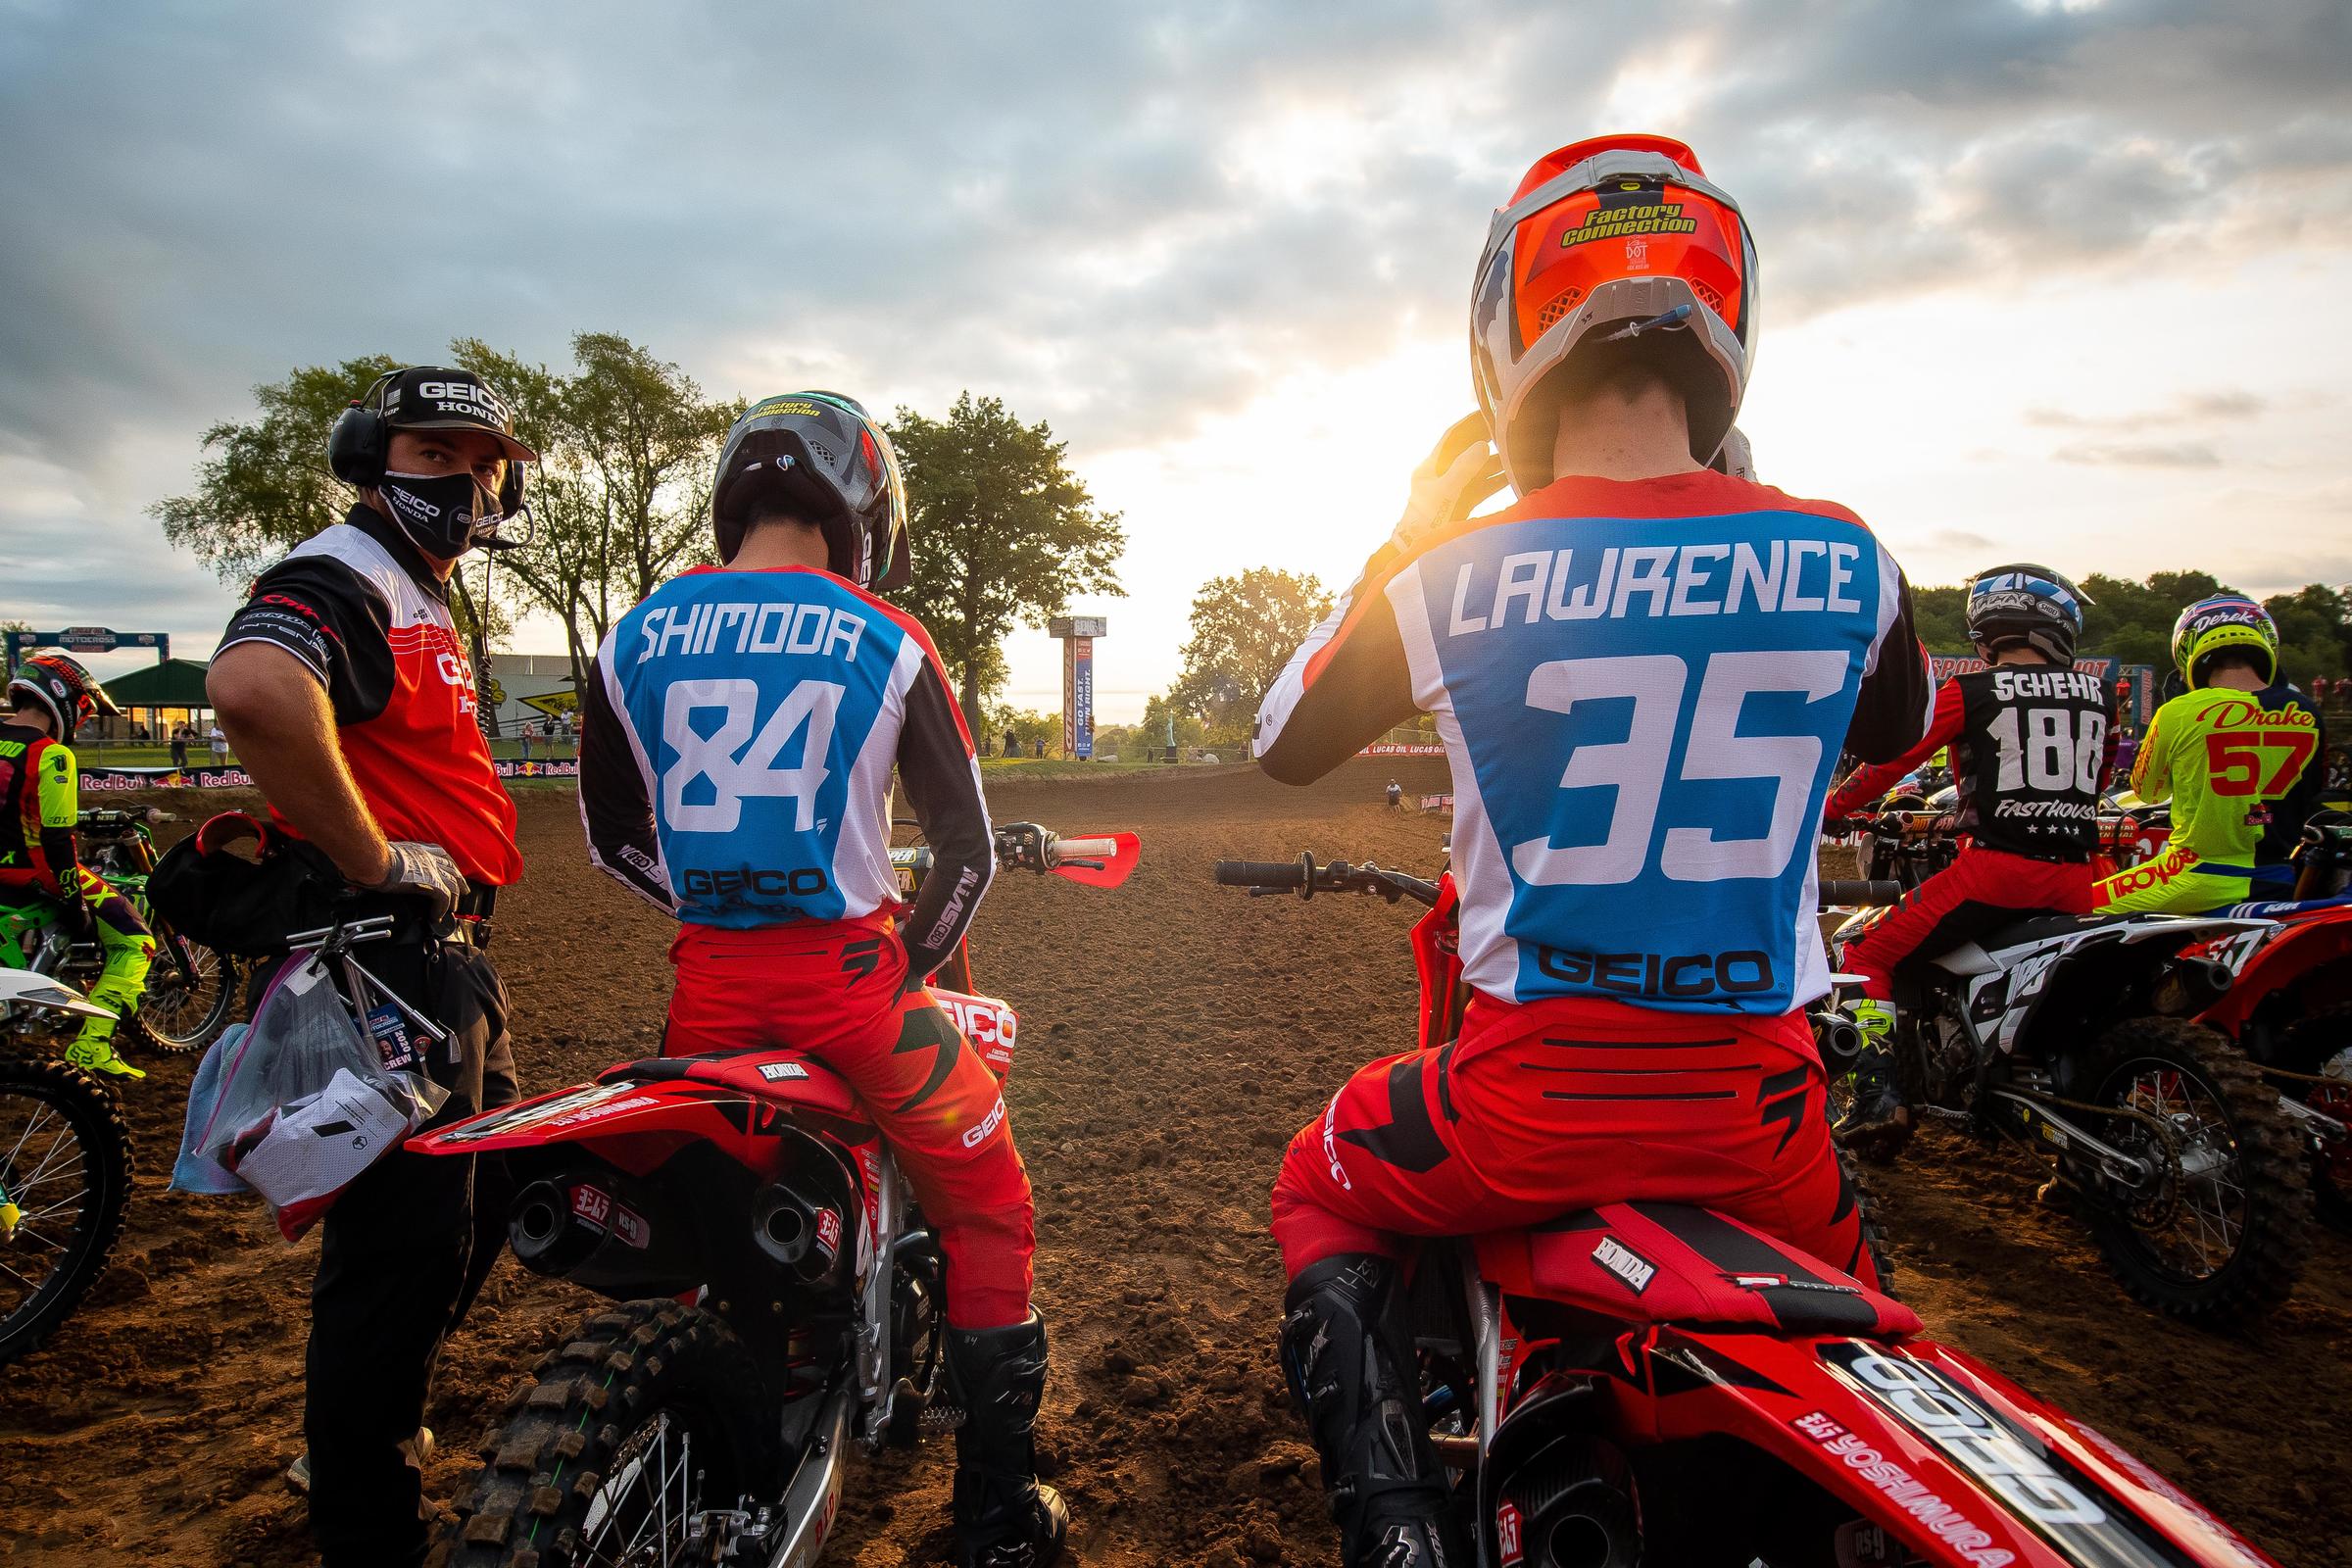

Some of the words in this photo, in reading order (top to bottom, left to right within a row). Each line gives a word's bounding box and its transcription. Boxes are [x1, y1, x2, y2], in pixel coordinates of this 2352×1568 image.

[1585, 204, 1681, 226] Factory
[1561, 218, 1695, 247] Connection
[419, 381, 509, 422] GEICO
[436, 401, 506, 432] HONDA
[392, 485, 440, 517] GEICO
[392, 496, 428, 522] HONDA
[475, 512, 503, 527] GEICO
[1448, 539, 1861, 637] LAWRENCE
[2040, 603, 2059, 616] SHOEI
[2193, 611, 2255, 632] Derek
[637, 603, 867, 664] SHIMODA
[1991, 671, 2105, 706] SCHEHR
[1078, 710, 1084, 726] GO
[2196, 700, 2317, 728] Drake
[496, 763, 513, 775] Bull
[546, 762, 564, 775] Red
[662, 679, 847, 833] 84
[1512, 650, 1850, 886] 35
[2205, 728, 2319, 800] 57
[80, 773, 114, 790] Red
[200, 770, 231, 786] Red
[1994, 798, 2098, 822] FASTHOUS
[683, 868, 827, 897] GEICO
[2110, 862, 2170, 900] TROY
[2262, 901, 2301, 913] KTM
[1539, 950, 1775, 996] GEICO
[394, 1030, 412, 1053] 2020
[383, 1053, 412, 1071] CREW
[760, 1062, 808, 1080] HONDA
[962, 1097, 1005, 1149] GEIC
[1592, 1236, 1656, 1291] HONDA
[1824, 1432, 2017, 1568] YOSHIMURA
